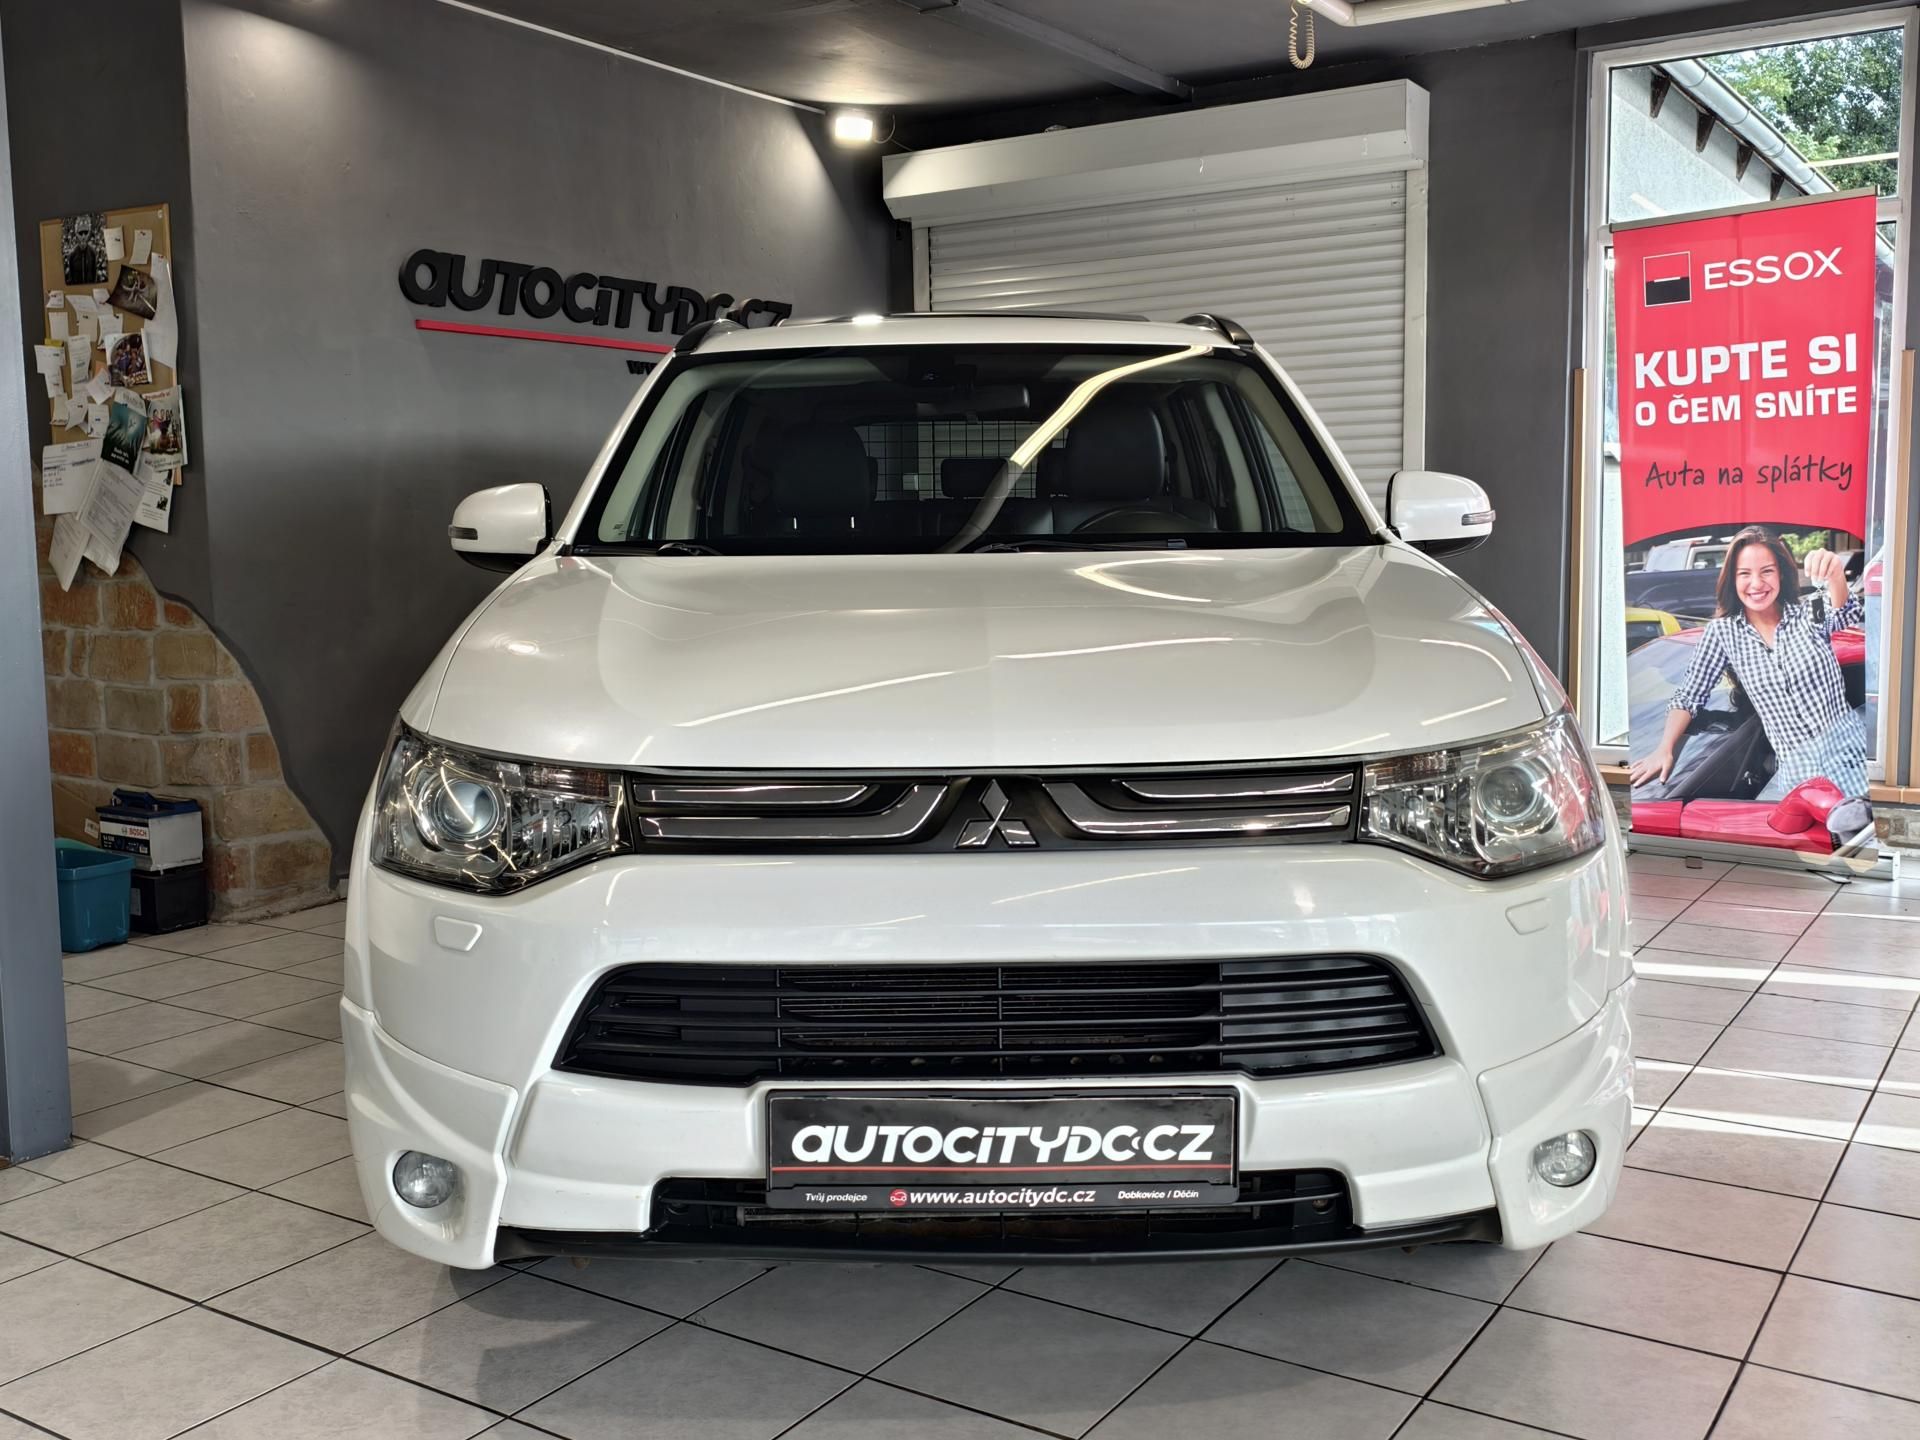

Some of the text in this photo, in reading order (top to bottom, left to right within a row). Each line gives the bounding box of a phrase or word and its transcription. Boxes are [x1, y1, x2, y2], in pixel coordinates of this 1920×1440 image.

[1703, 246, 1843, 290] ESSOX
[1634, 332, 1858, 390] KUPTE SI
[1635, 384, 1858, 427] O ČEM SNÍTE
[1644, 454, 1854, 492] Auta na splátky
[128, 827, 147, 837] BOSCH
[805, 1191, 825, 1203] Tvůj
[826, 1192, 868, 1203] prodejce
[910, 1187, 1097, 1207] www.autocitydc.cz
[1117, 1190, 1166, 1200] Dobkovice
[1173, 1189, 1200, 1199] Děčín
